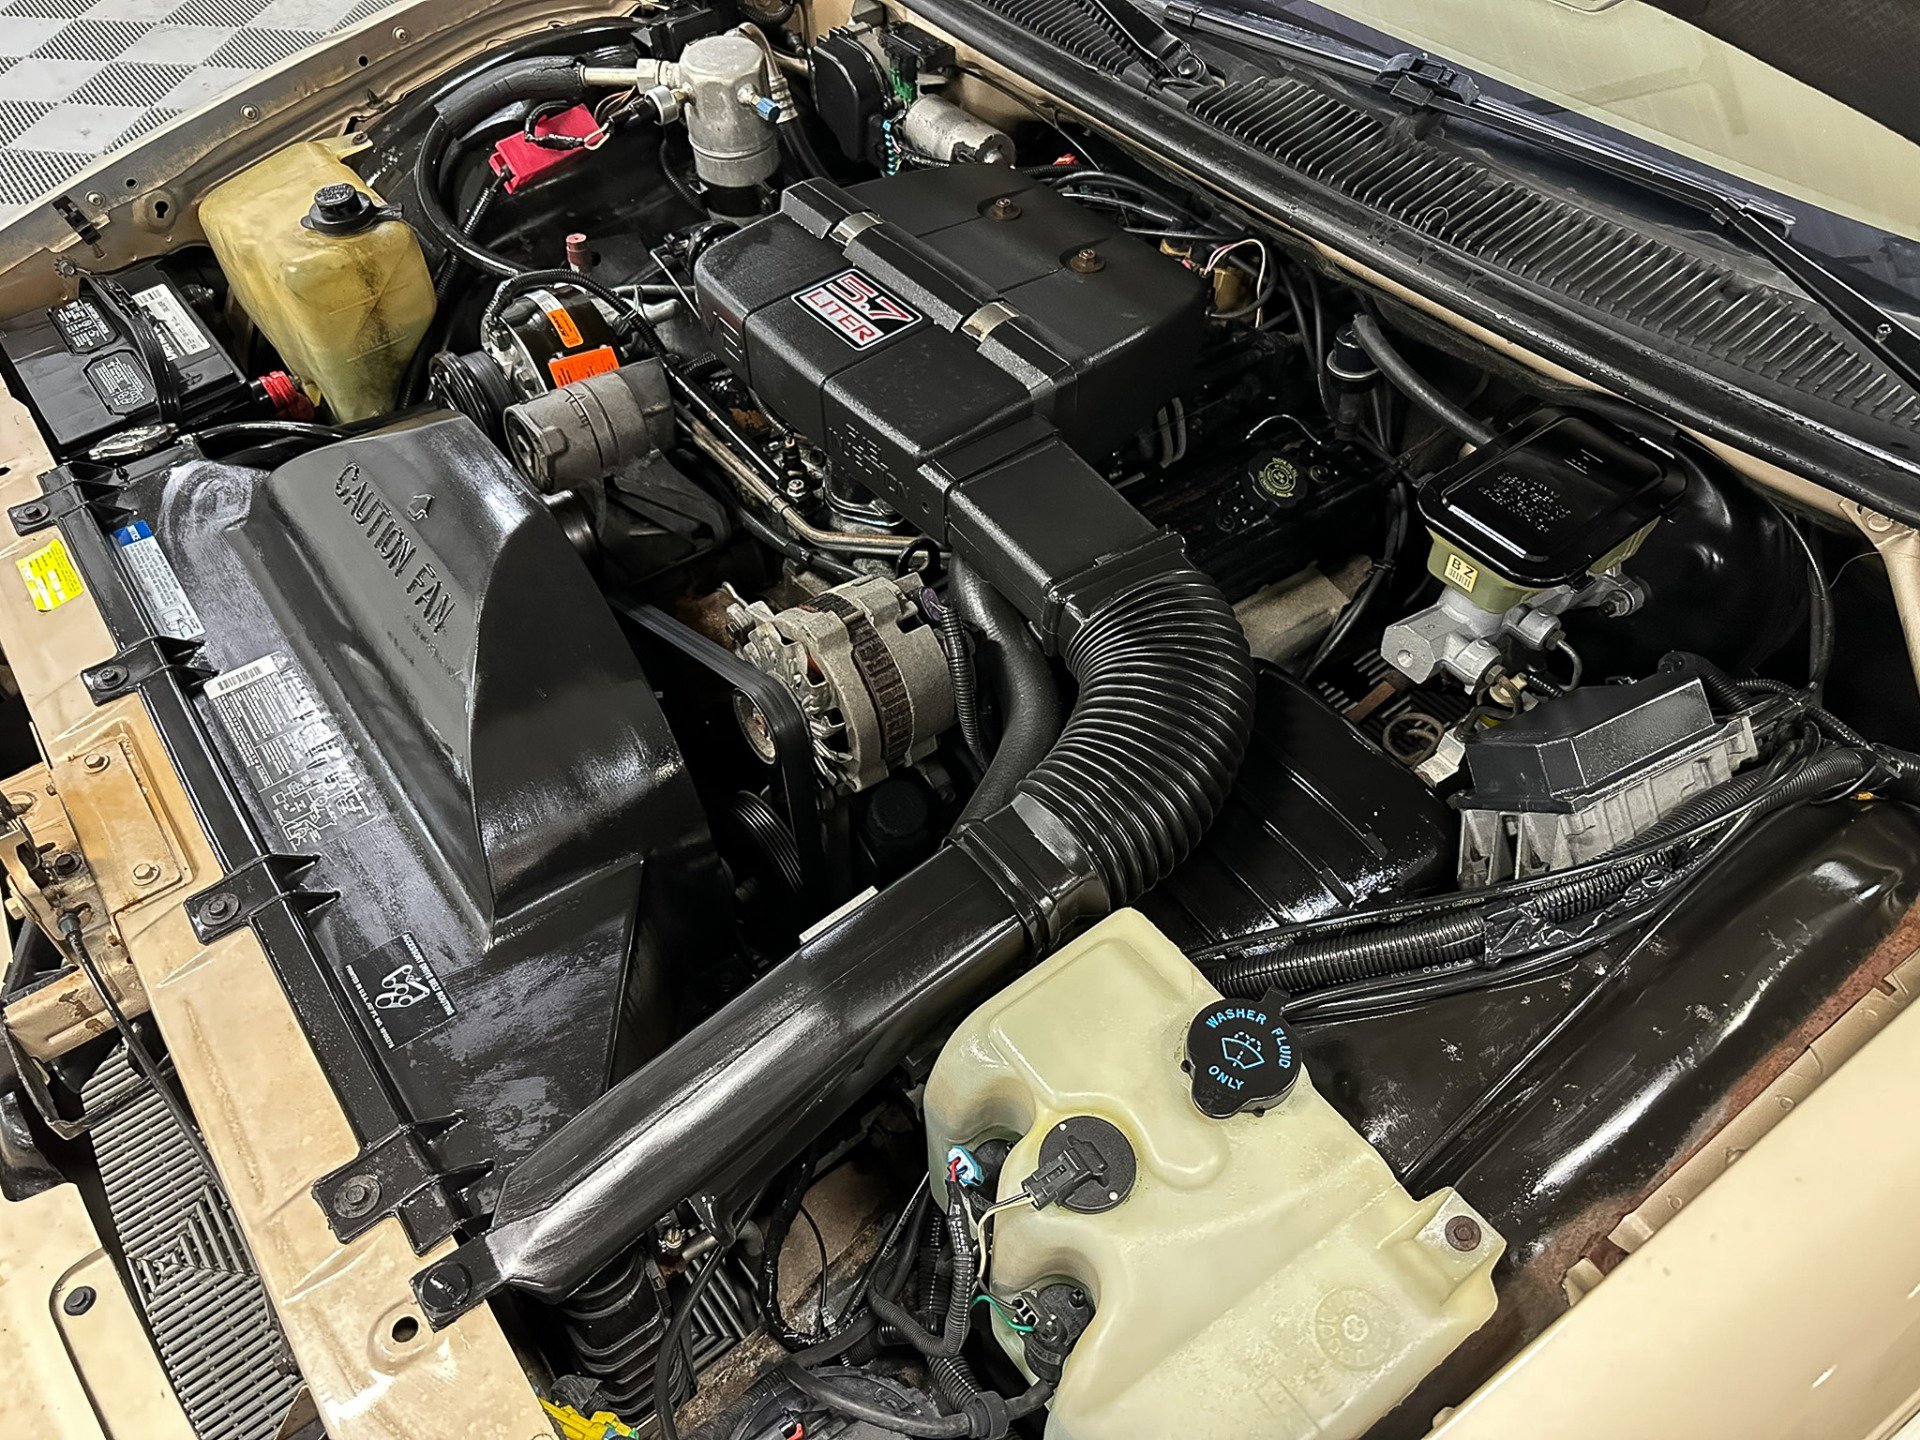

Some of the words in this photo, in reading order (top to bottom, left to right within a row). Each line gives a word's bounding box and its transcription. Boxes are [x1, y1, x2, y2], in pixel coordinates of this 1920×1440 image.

[806, 290, 876, 342] LITER
[825, 273, 914, 322] 5.7
[335, 462, 417, 578] CAUTION
[406, 562, 456, 635] FAN
[402, 933, 424, 963] ACCESSORY
[419, 962, 434, 979] DRIVE
[428, 978, 442, 993] BELT
[436, 990, 455, 1016] ROUTING
[1205, 1008, 1267, 1029] WASHER
[1271, 1027, 1292, 1069] FLUID
[1208, 1065, 1245, 1091] ONLY
